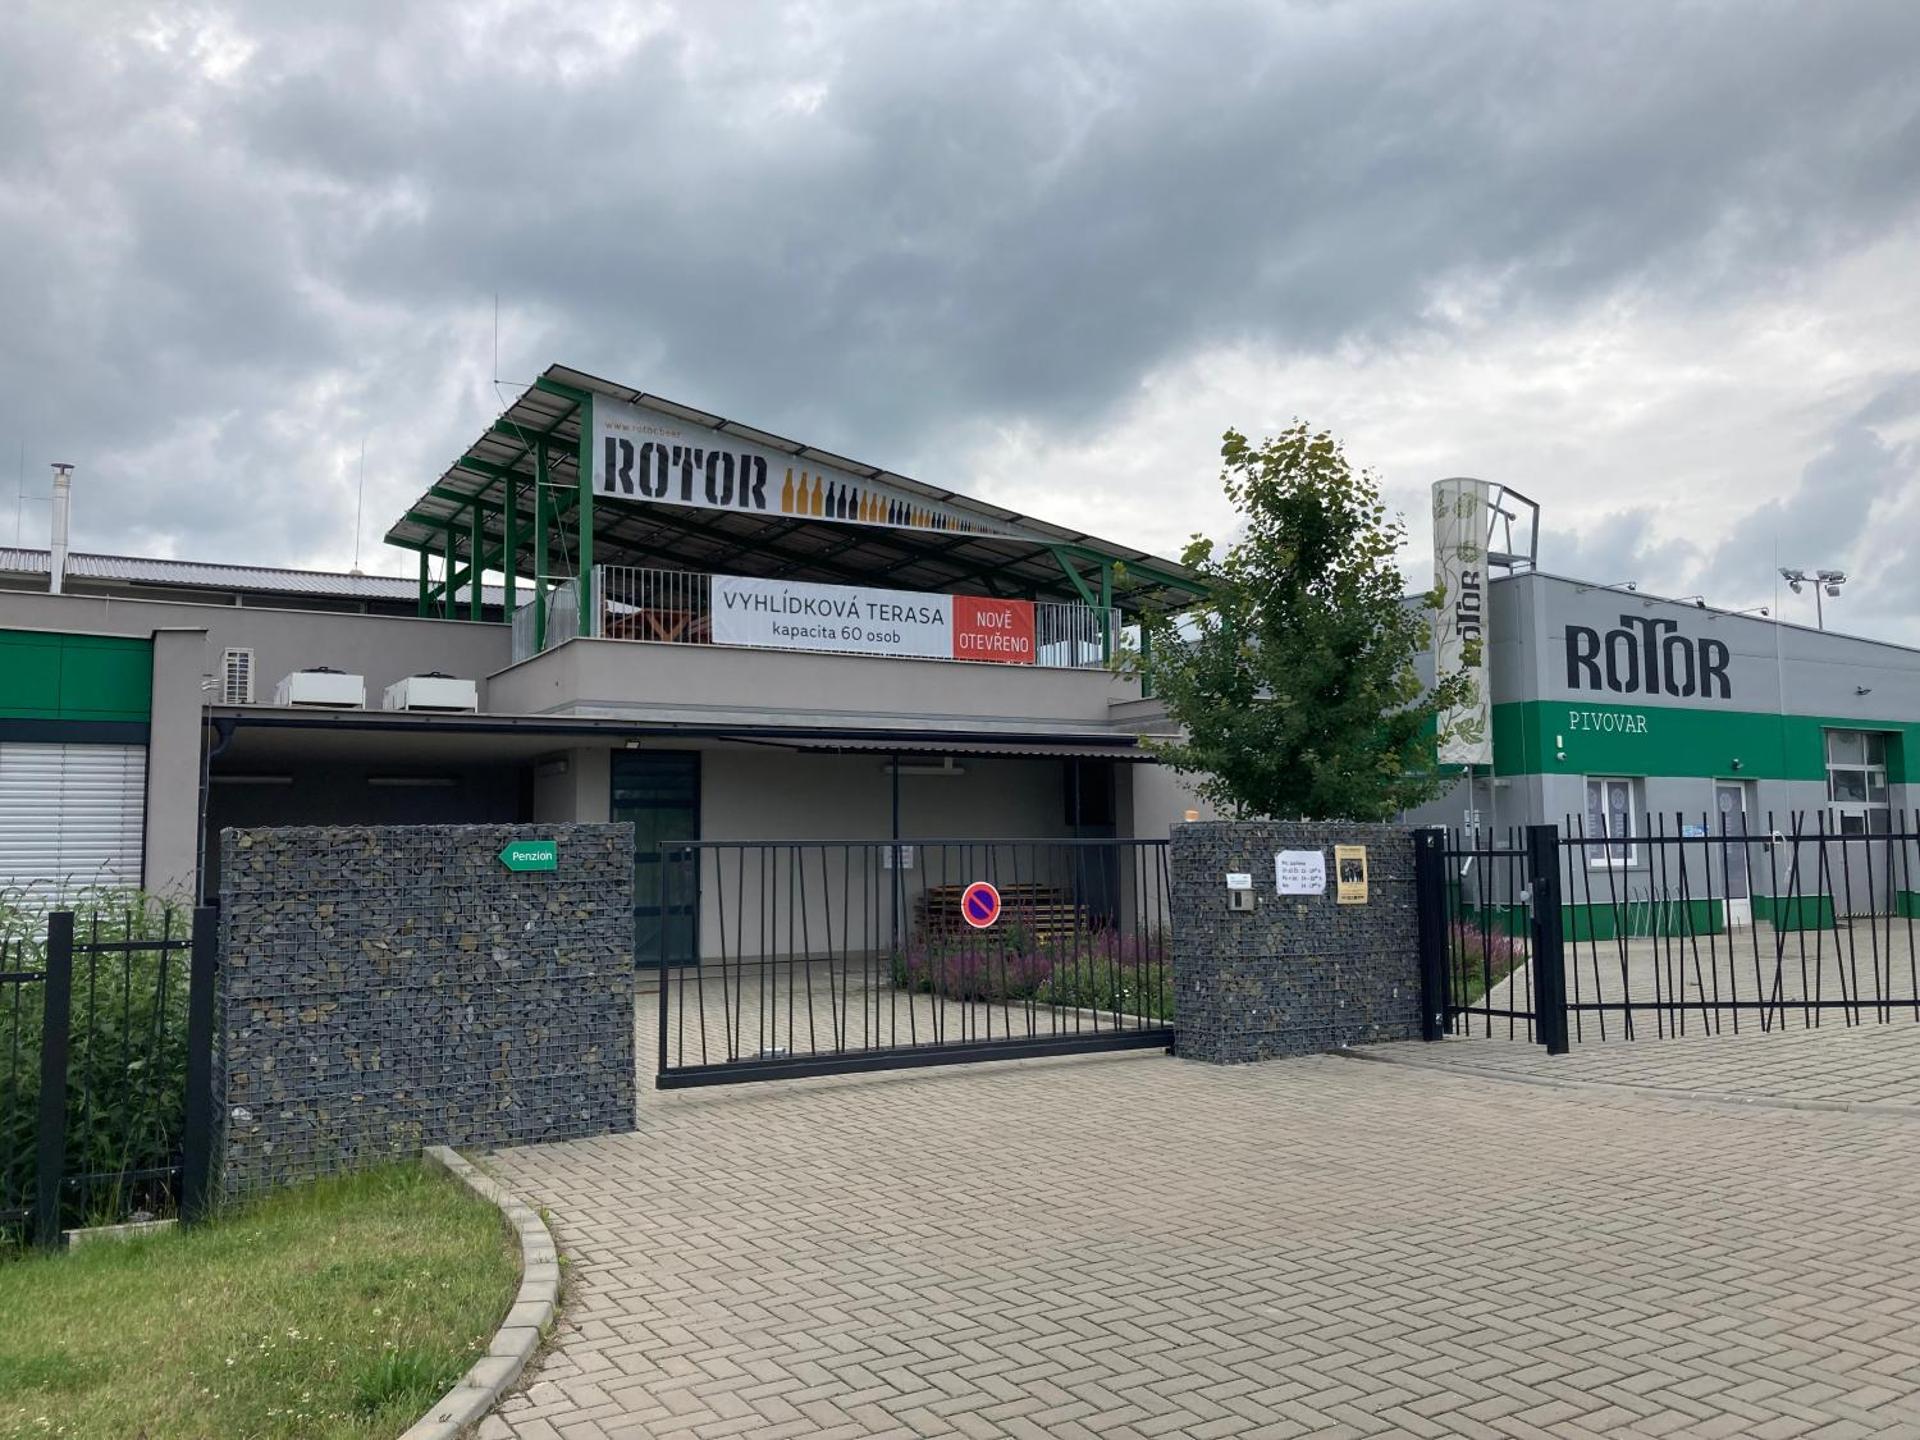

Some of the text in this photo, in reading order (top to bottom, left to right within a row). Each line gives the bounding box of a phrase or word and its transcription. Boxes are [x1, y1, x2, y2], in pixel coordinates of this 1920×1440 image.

[604, 437, 768, 510] ROTOR
[723, 588, 945, 626] VYHLÍDKOVÁ TERASA
[1456, 570, 1481, 657] OTOR
[976, 610, 1013, 630] NOVĚ
[772, 622, 902, 644] kapacita 60 osob
[959, 631, 1030, 654] OTEVŘENO
[1565, 614, 1732, 699] ROTOR
[1569, 711, 1648, 734] PIVOVAR
[512, 850, 553, 862] Penzion
